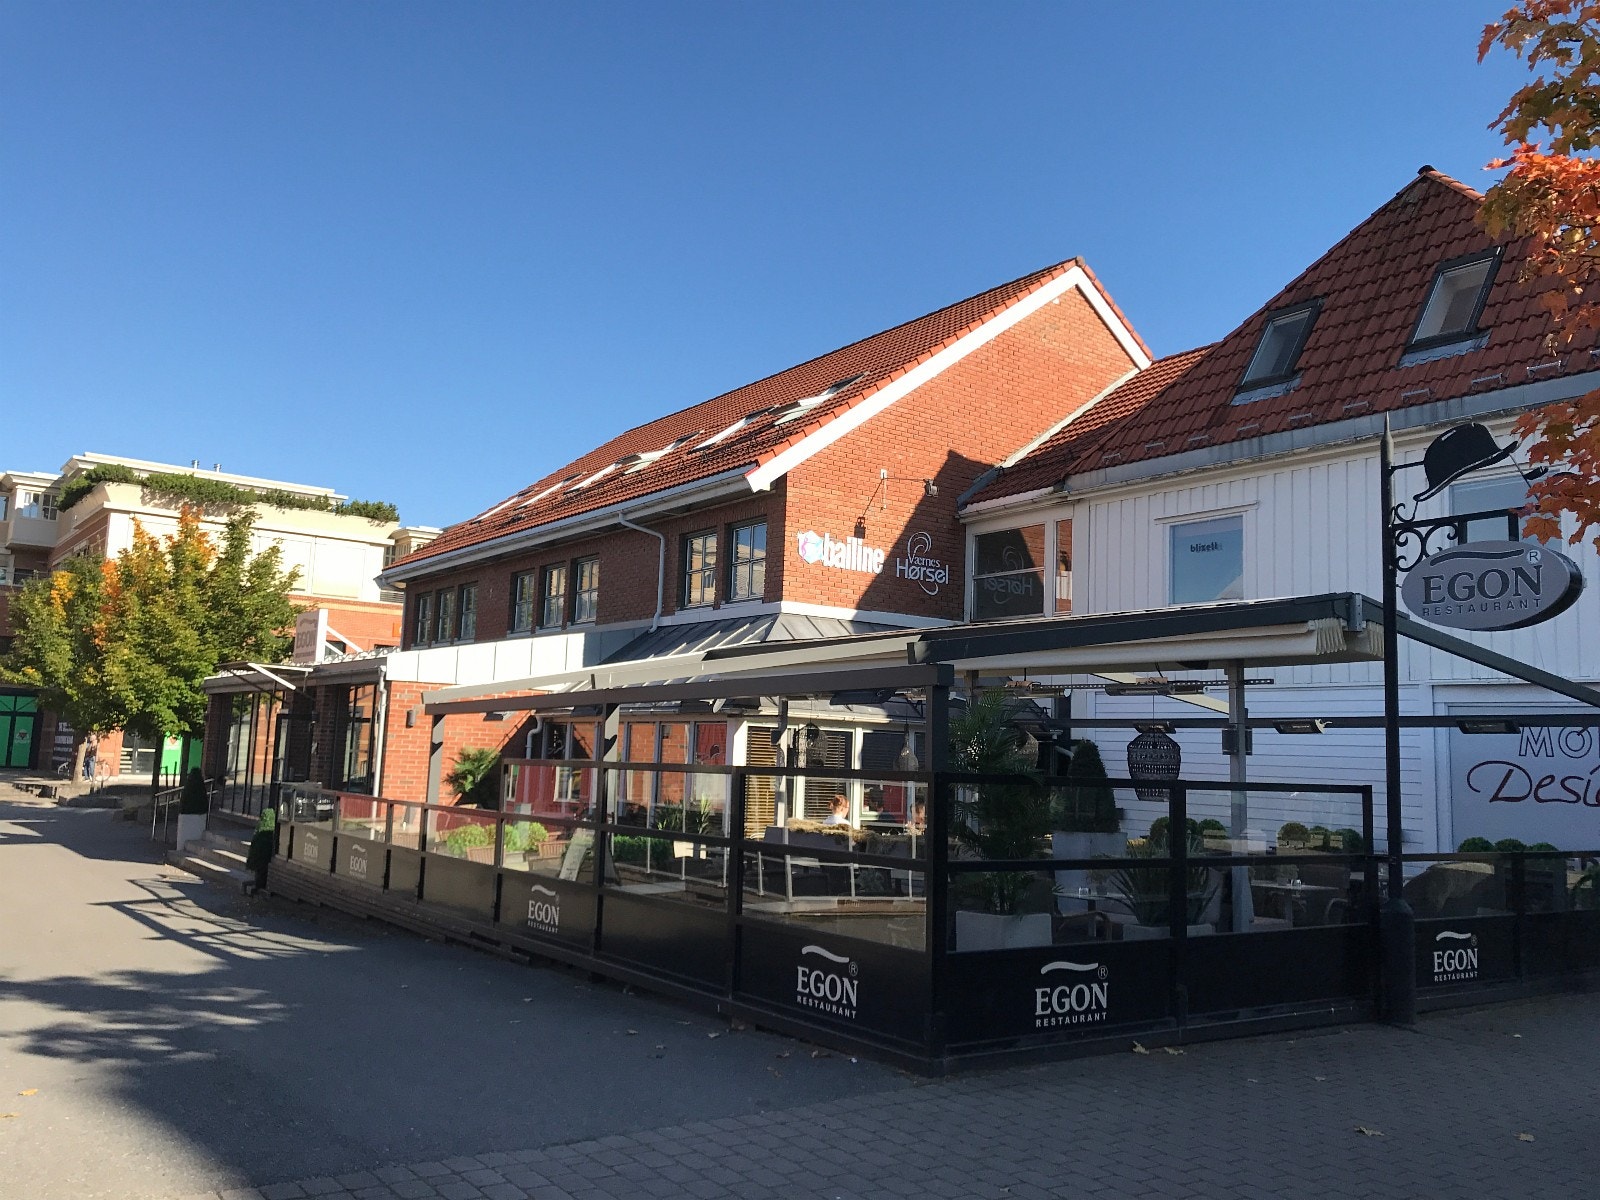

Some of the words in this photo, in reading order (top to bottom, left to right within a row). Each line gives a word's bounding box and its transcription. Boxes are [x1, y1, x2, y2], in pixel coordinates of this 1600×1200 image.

[823, 532, 885, 574] bailine
[908, 553, 941, 568] Værnes
[896, 557, 949, 584] Hørsel
[1422, 564, 1543, 605] EGON
[1422, 597, 1542, 617] RESTAURANT
[1518, 726, 1600, 759] MO
[1466, 760, 1600, 807] Desi
[349, 855, 368, 874] EGON
[527, 900, 560, 926] EGON
[1433, 948, 1478, 973] EGON
[796, 965, 859, 1007] EGON
[1434, 971, 1478, 982] RESTAURANT
[797, 995, 857, 1019] RESTAURANT
[1035, 982, 1109, 1016] EGON
[1035, 1012, 1107, 1028] RESTAURANT
